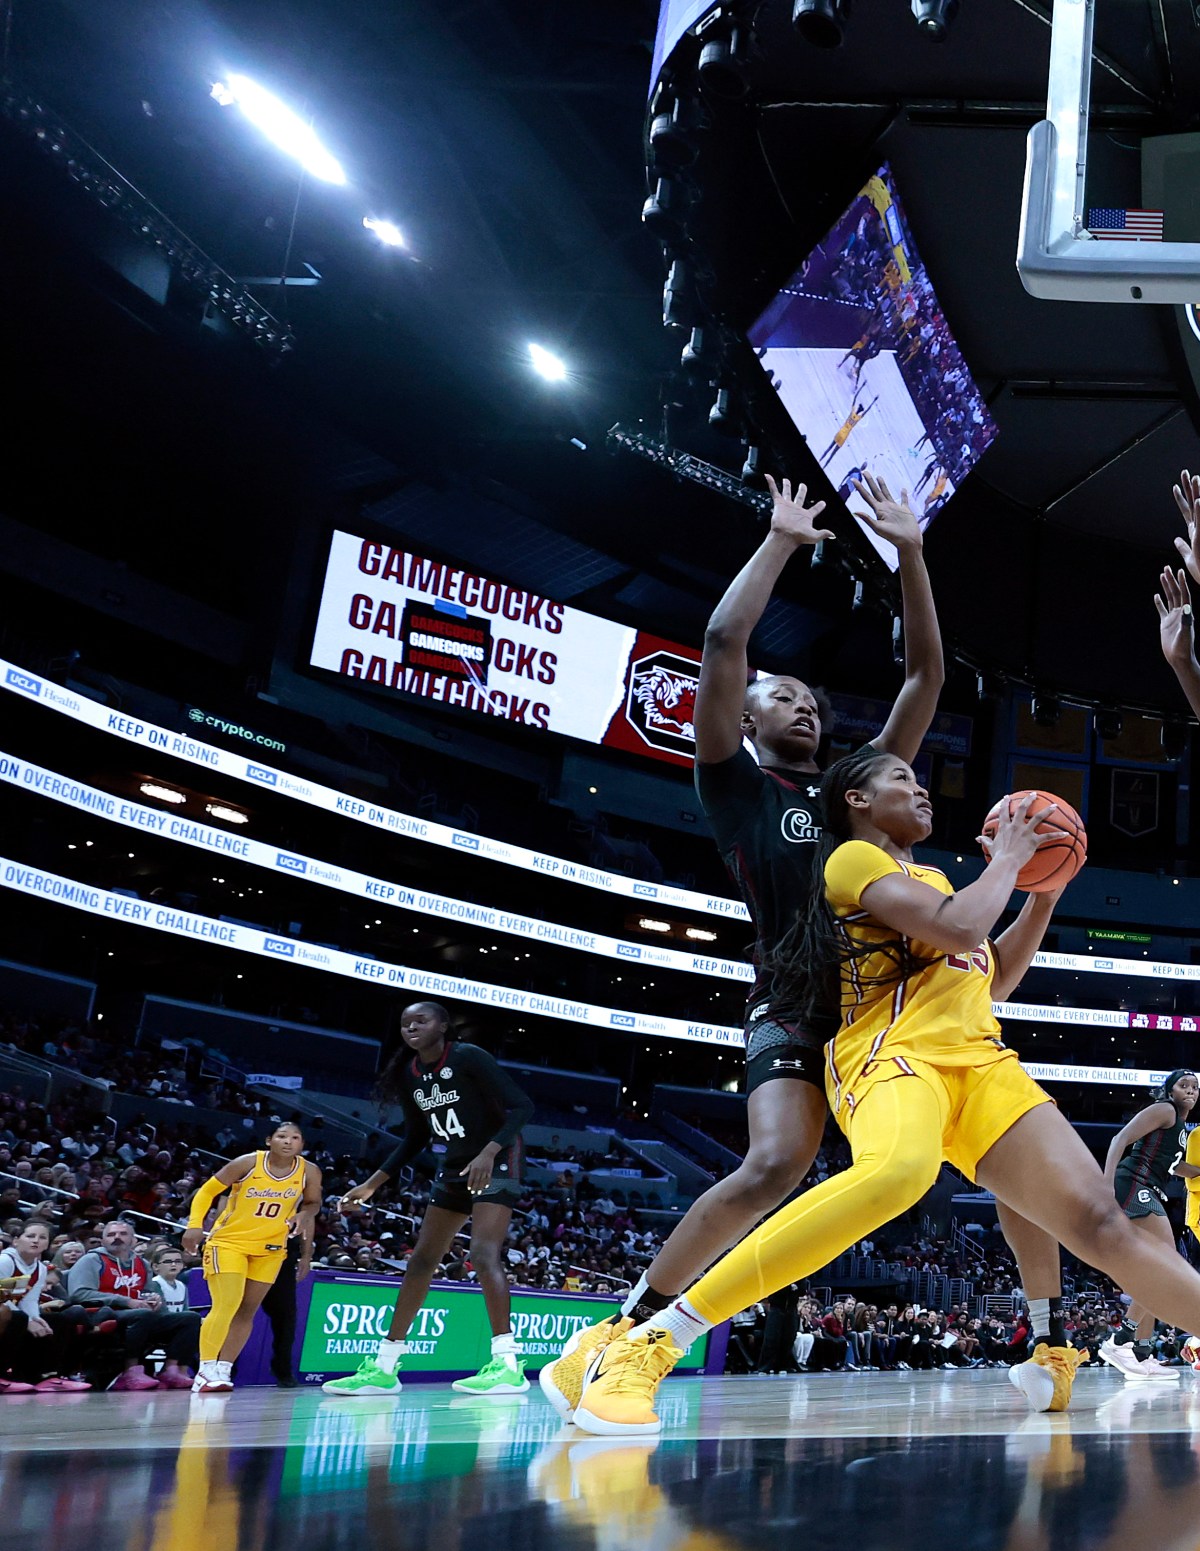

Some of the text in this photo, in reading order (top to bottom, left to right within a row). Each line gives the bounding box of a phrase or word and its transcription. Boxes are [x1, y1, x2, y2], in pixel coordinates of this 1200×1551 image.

[358, 539, 565, 634] GAMECOCKS
[409, 632, 484, 662] GAMECOCKS
[8, 674, 39, 693] UCLA
[107, 714, 219, 765] KEEP ON RISING
[205, 716, 286, 752] crypto.com
[249, 767, 276, 784] UCLA
[24, 769, 250, 857] OVERCOMING EVERY CHALLENGE
[336, 797, 428, 836] KEEP ON RISING
[454, 835, 478, 848] UCLA
[279, 856, 304, 871] UCLA
[532, 856, 612, 887] KEEP ON RISING
[635, 885, 656, 897] UCLA
[5, 866, 236, 943] OVERCOMING EVERY CHALLENGE
[707, 899, 732, 913] KEEP
[365, 881, 596, 948] KEEP ON OVERCOMING EVERY CHALLENGE
[266, 940, 292, 954] UCLA
[619, 946, 639, 957] UCLA
[692, 958, 718, 972] KEEP
[721, 962, 734, 974] ON
[1036, 955, 1077, 966] ON RISING
[1152, 966, 1185, 975] KEEP ON
[354, 961, 589, 1019] KEEP ON OVERCOMING EVERY CHALLENGE
[612, 1016, 634, 1026] UCLA
[1006, 1006, 1089, 1021] OVERCOMING EVERY
[687, 1025, 712, 1038] KEEP
[716, 1030, 729, 1041] ON
[1062, 1070, 1138, 1082] EVERY CHALLENGE
[414, 1083, 460, 1111] Carolina
[431, 1109, 465, 1141] 44
[246, 1188, 281, 1198] Southern
[254, 1201, 281, 1218] 10
[323, 1303, 446, 1336] SPROTS
[408, 1340, 437, 1354] RKET
[518, 1344, 548, 1354] RMERS
